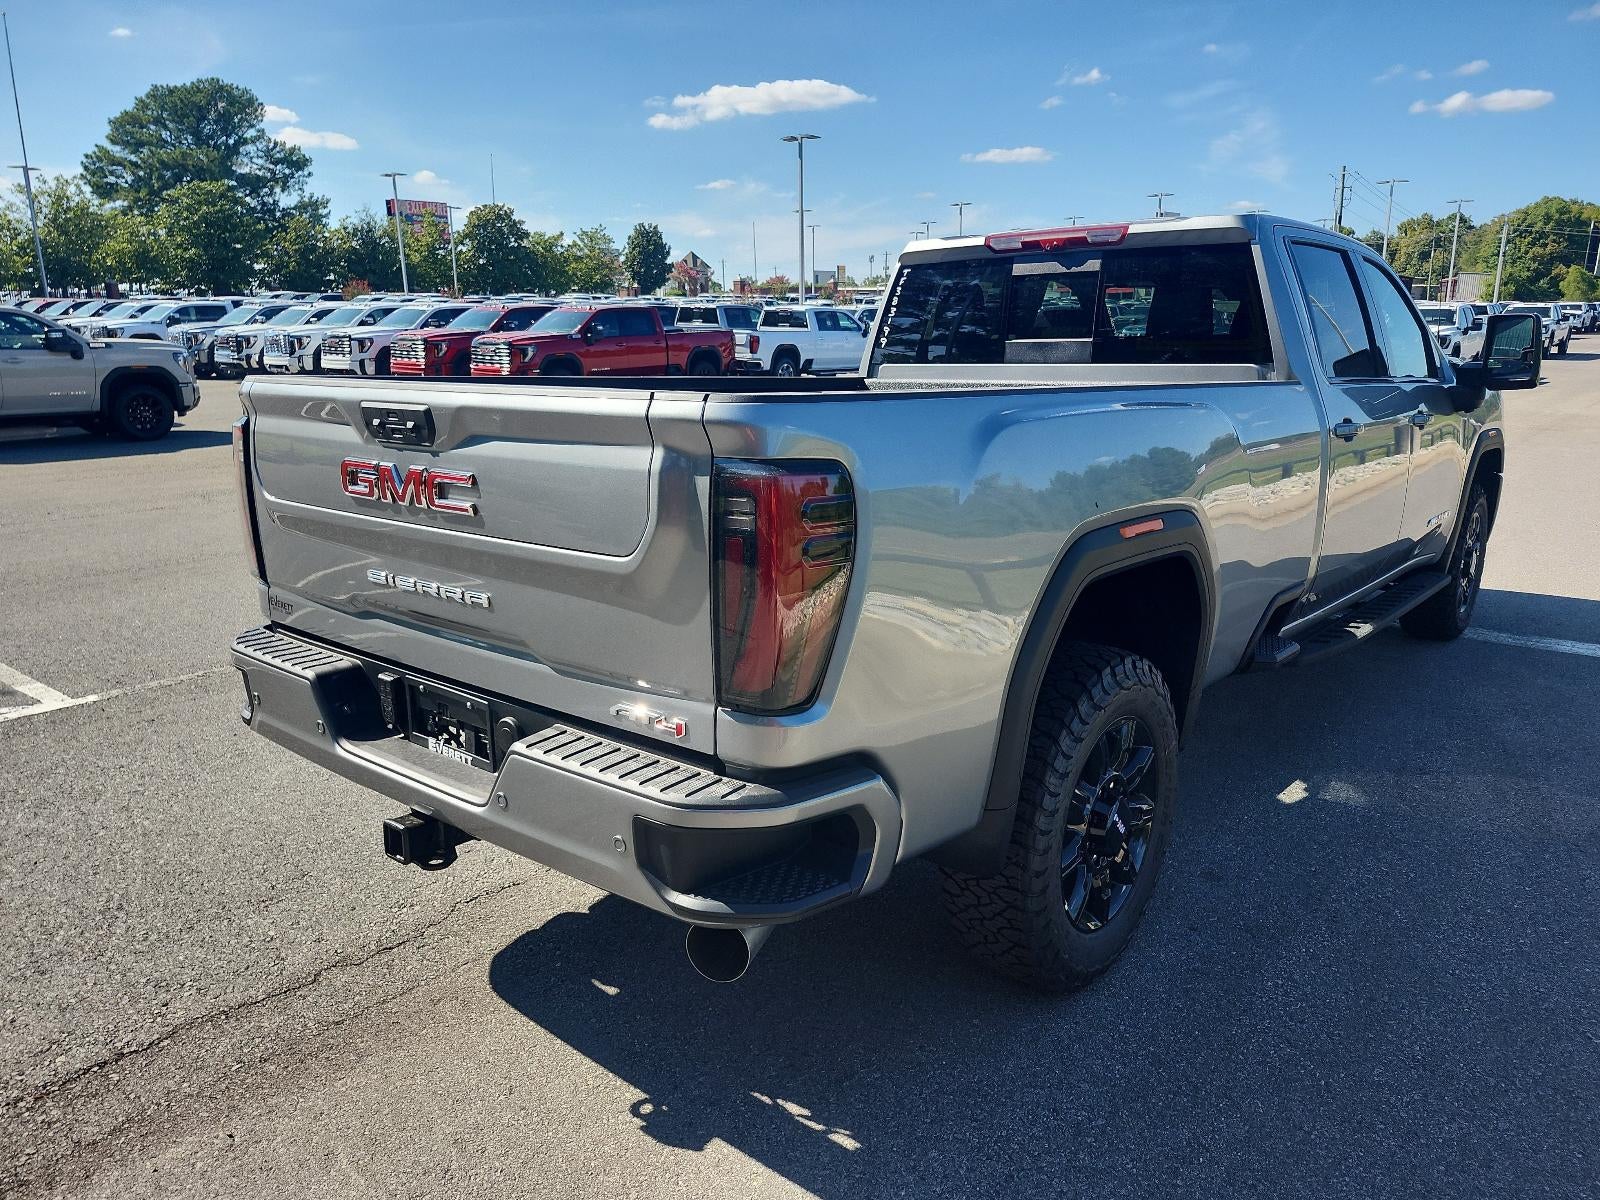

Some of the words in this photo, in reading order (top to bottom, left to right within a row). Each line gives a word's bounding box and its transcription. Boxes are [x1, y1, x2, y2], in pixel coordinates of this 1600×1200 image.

[407, 201, 423, 214] EXIT
[340, 455, 478, 517] GMC
[270, 594, 294, 611] EVERETT
[366, 567, 493, 608] SIERRA
[428, 736, 473, 767] EVERETT
